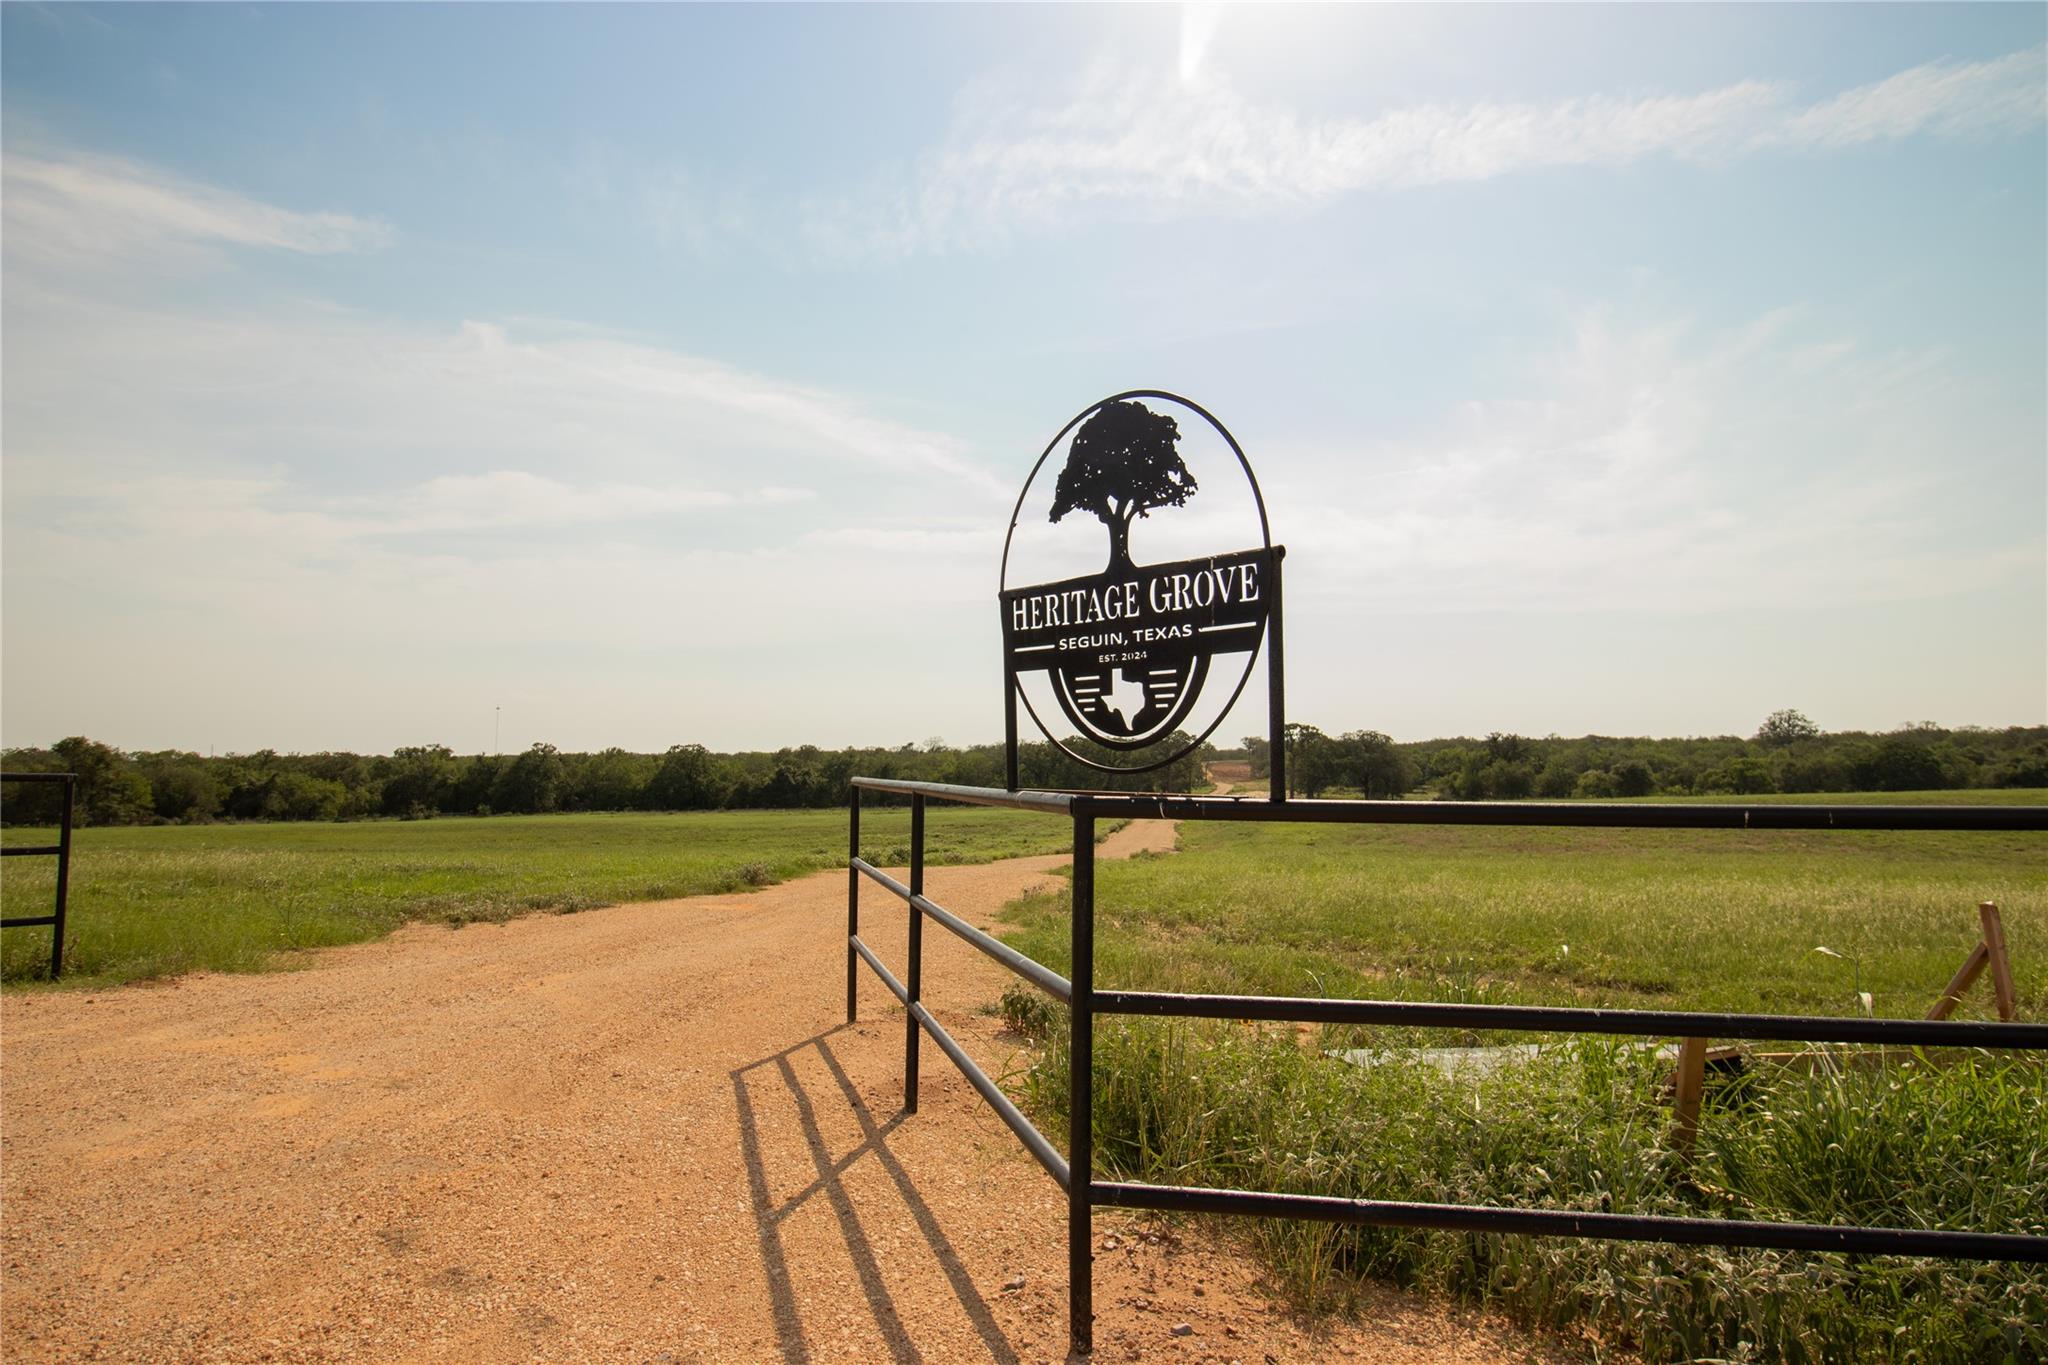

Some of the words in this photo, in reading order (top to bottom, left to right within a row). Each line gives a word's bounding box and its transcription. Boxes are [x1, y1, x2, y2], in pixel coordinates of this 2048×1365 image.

[1013, 581, 1140, 631] HERITAGE
[1150, 563, 1259, 613] GROVE
[1059, 632, 1128, 650] SEGUIN,
[1133, 624, 1193, 642] TEXAS
[1098, 653, 1118, 663] EST.
[1121, 650, 1147, 661] 2024
